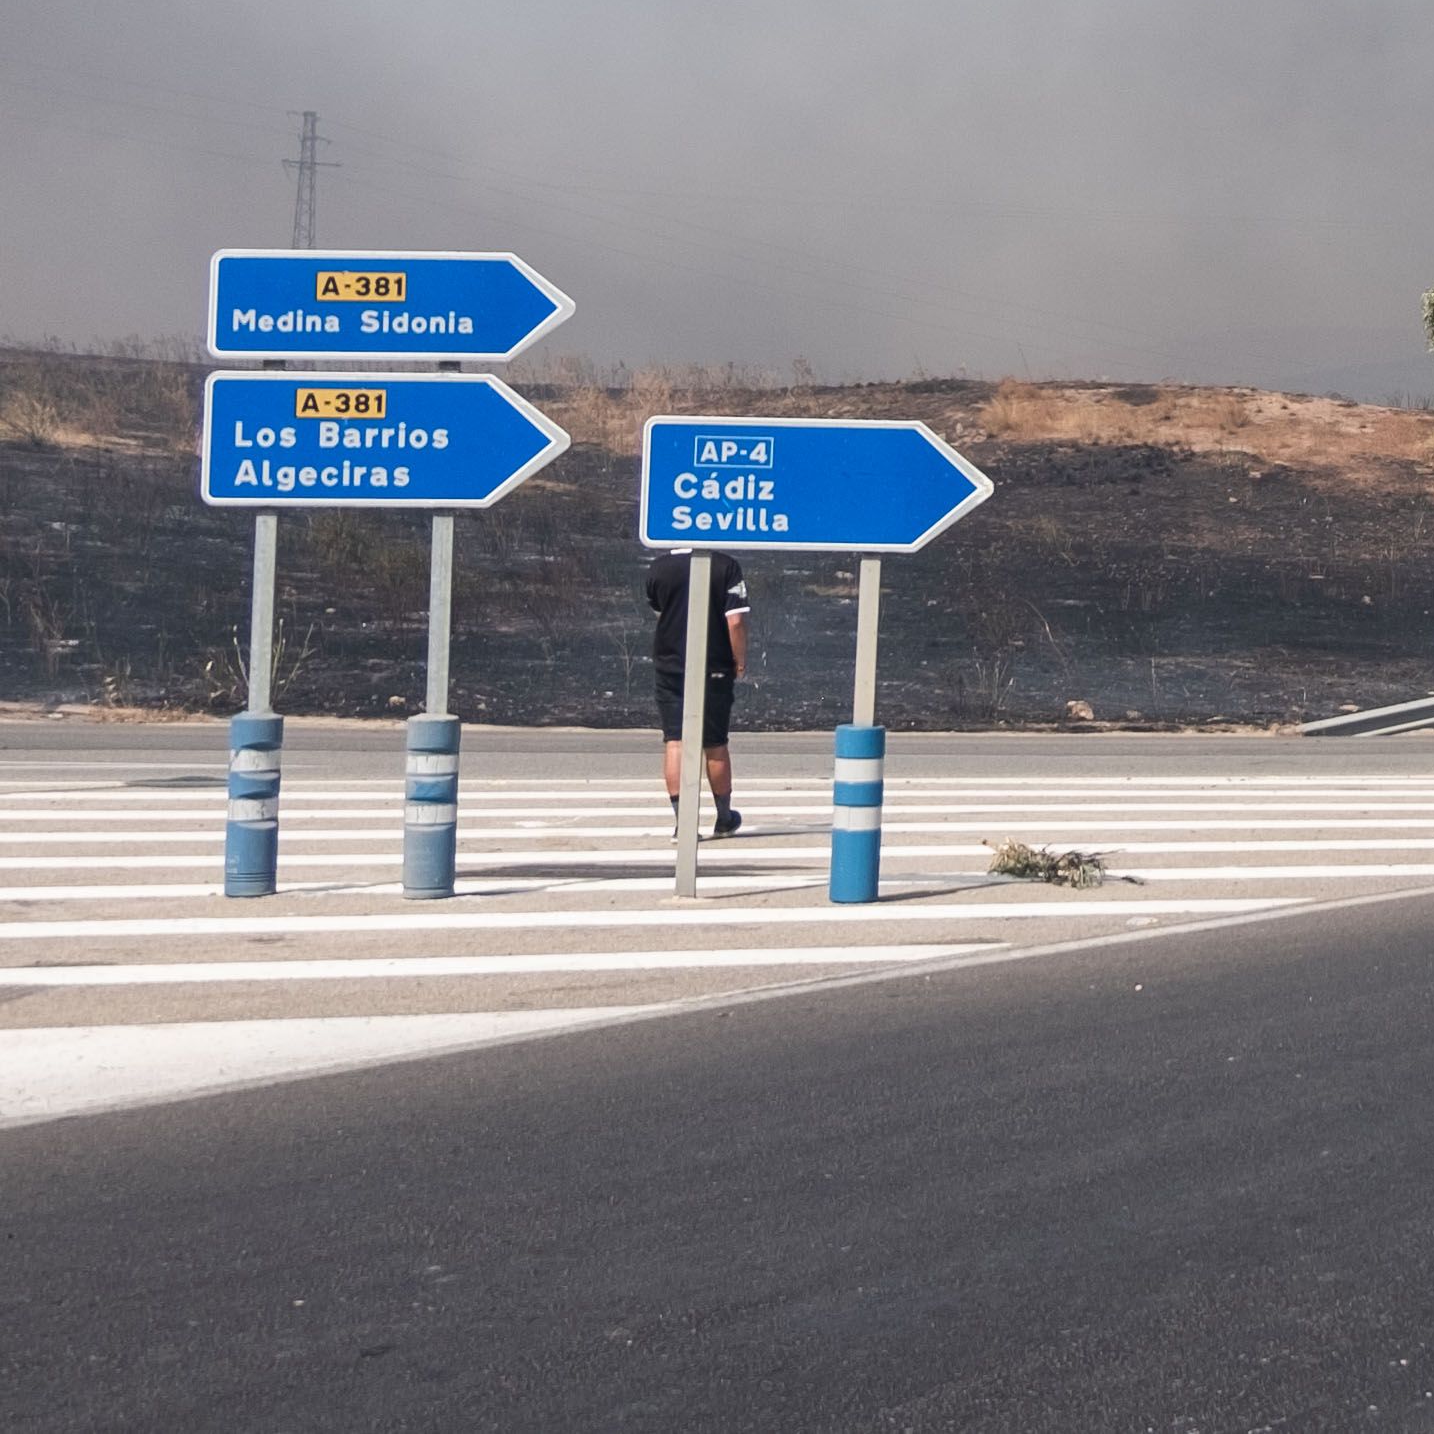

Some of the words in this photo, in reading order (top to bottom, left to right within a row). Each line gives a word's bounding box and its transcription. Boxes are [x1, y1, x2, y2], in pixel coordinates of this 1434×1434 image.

[321, 276, 404, 297] A-381
[232, 309, 340, 333] Medina
[360, 310, 474, 334] Sidonia
[301, 392, 383, 413] A-381
[234, 420, 297, 448] Los
[319, 421, 449, 449] Barrios
[700, 441, 768, 463] AP-4
[234, 459, 410, 492] Algeciras
[673, 472, 775, 500] Cádiz
[671, 506, 790, 532] Sevilla
